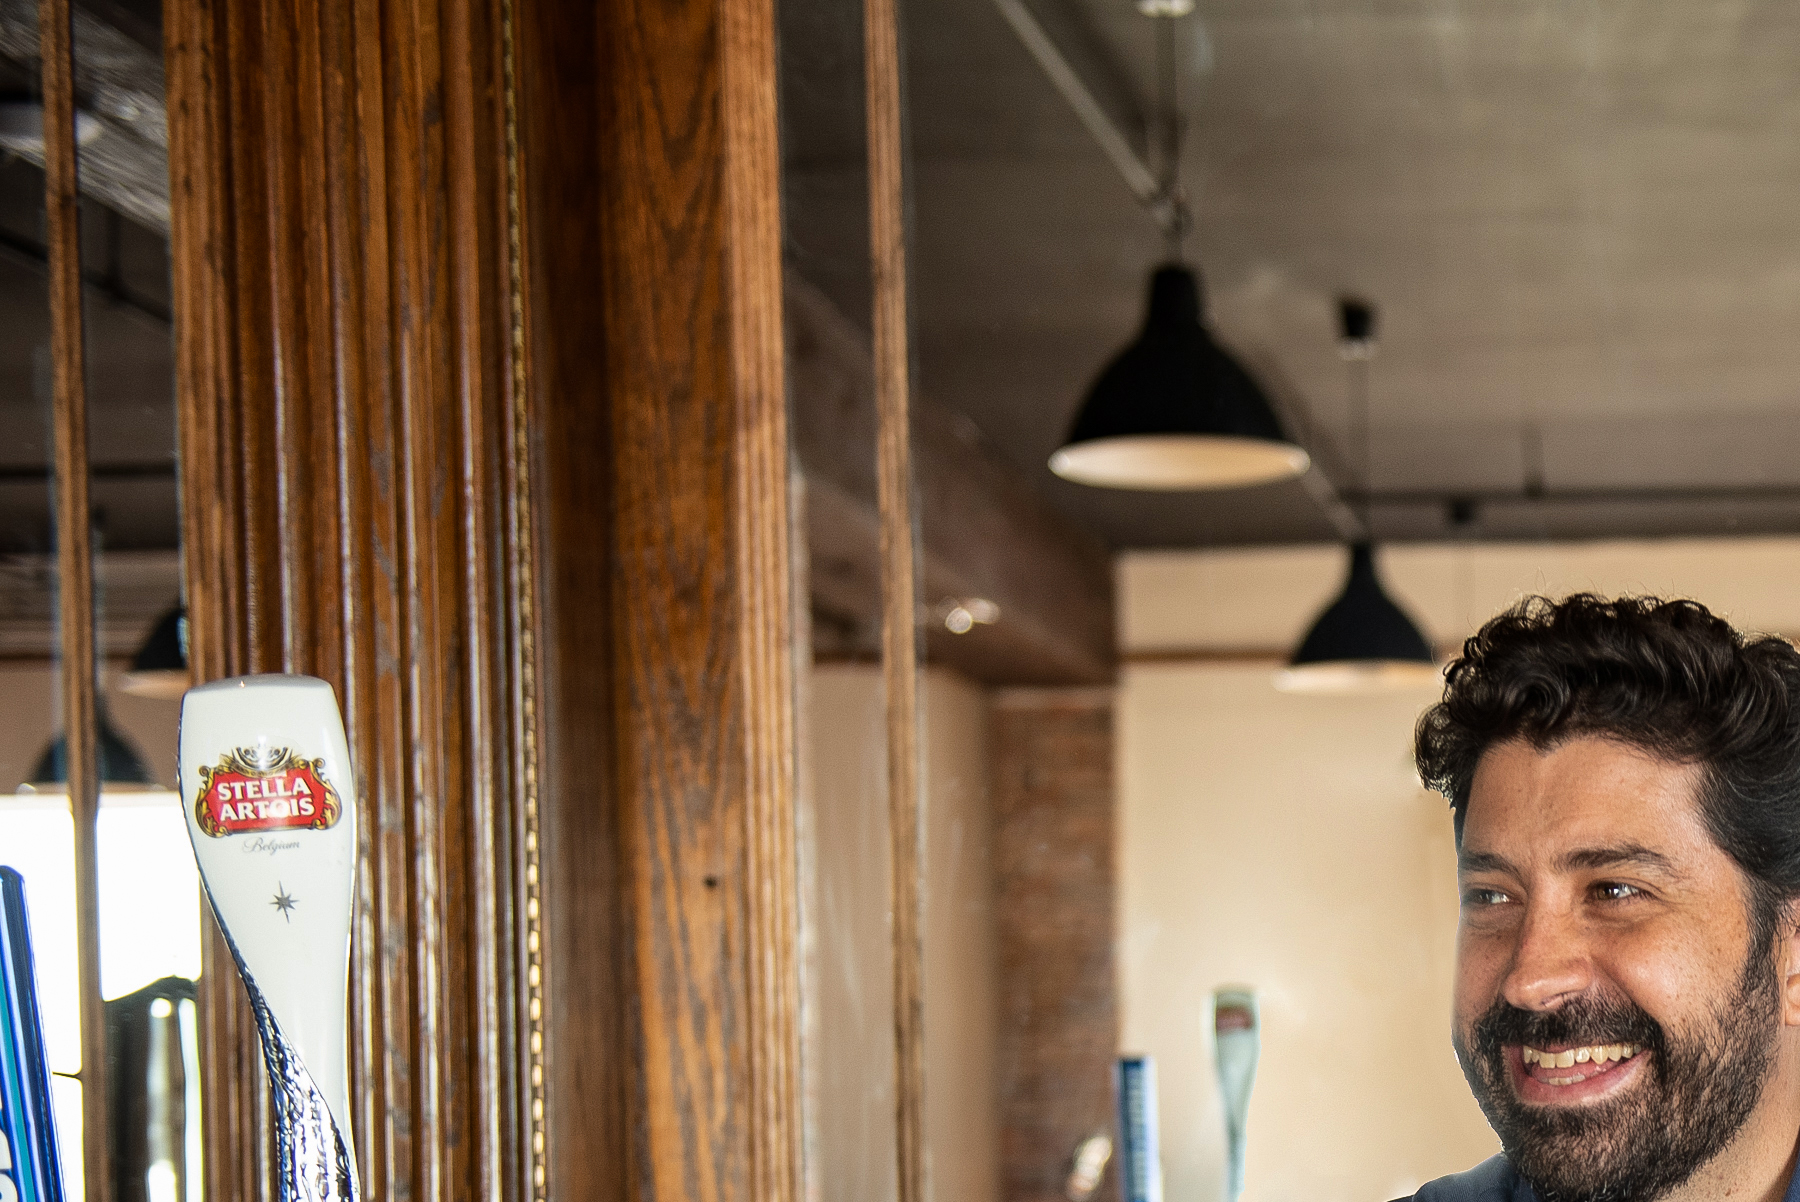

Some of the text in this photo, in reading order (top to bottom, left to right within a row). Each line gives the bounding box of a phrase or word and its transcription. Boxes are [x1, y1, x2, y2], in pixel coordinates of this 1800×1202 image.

[216, 776, 313, 801] STELLA
[219, 796, 316, 822] ARTOIS
[242, 836, 301, 856] Belgium
